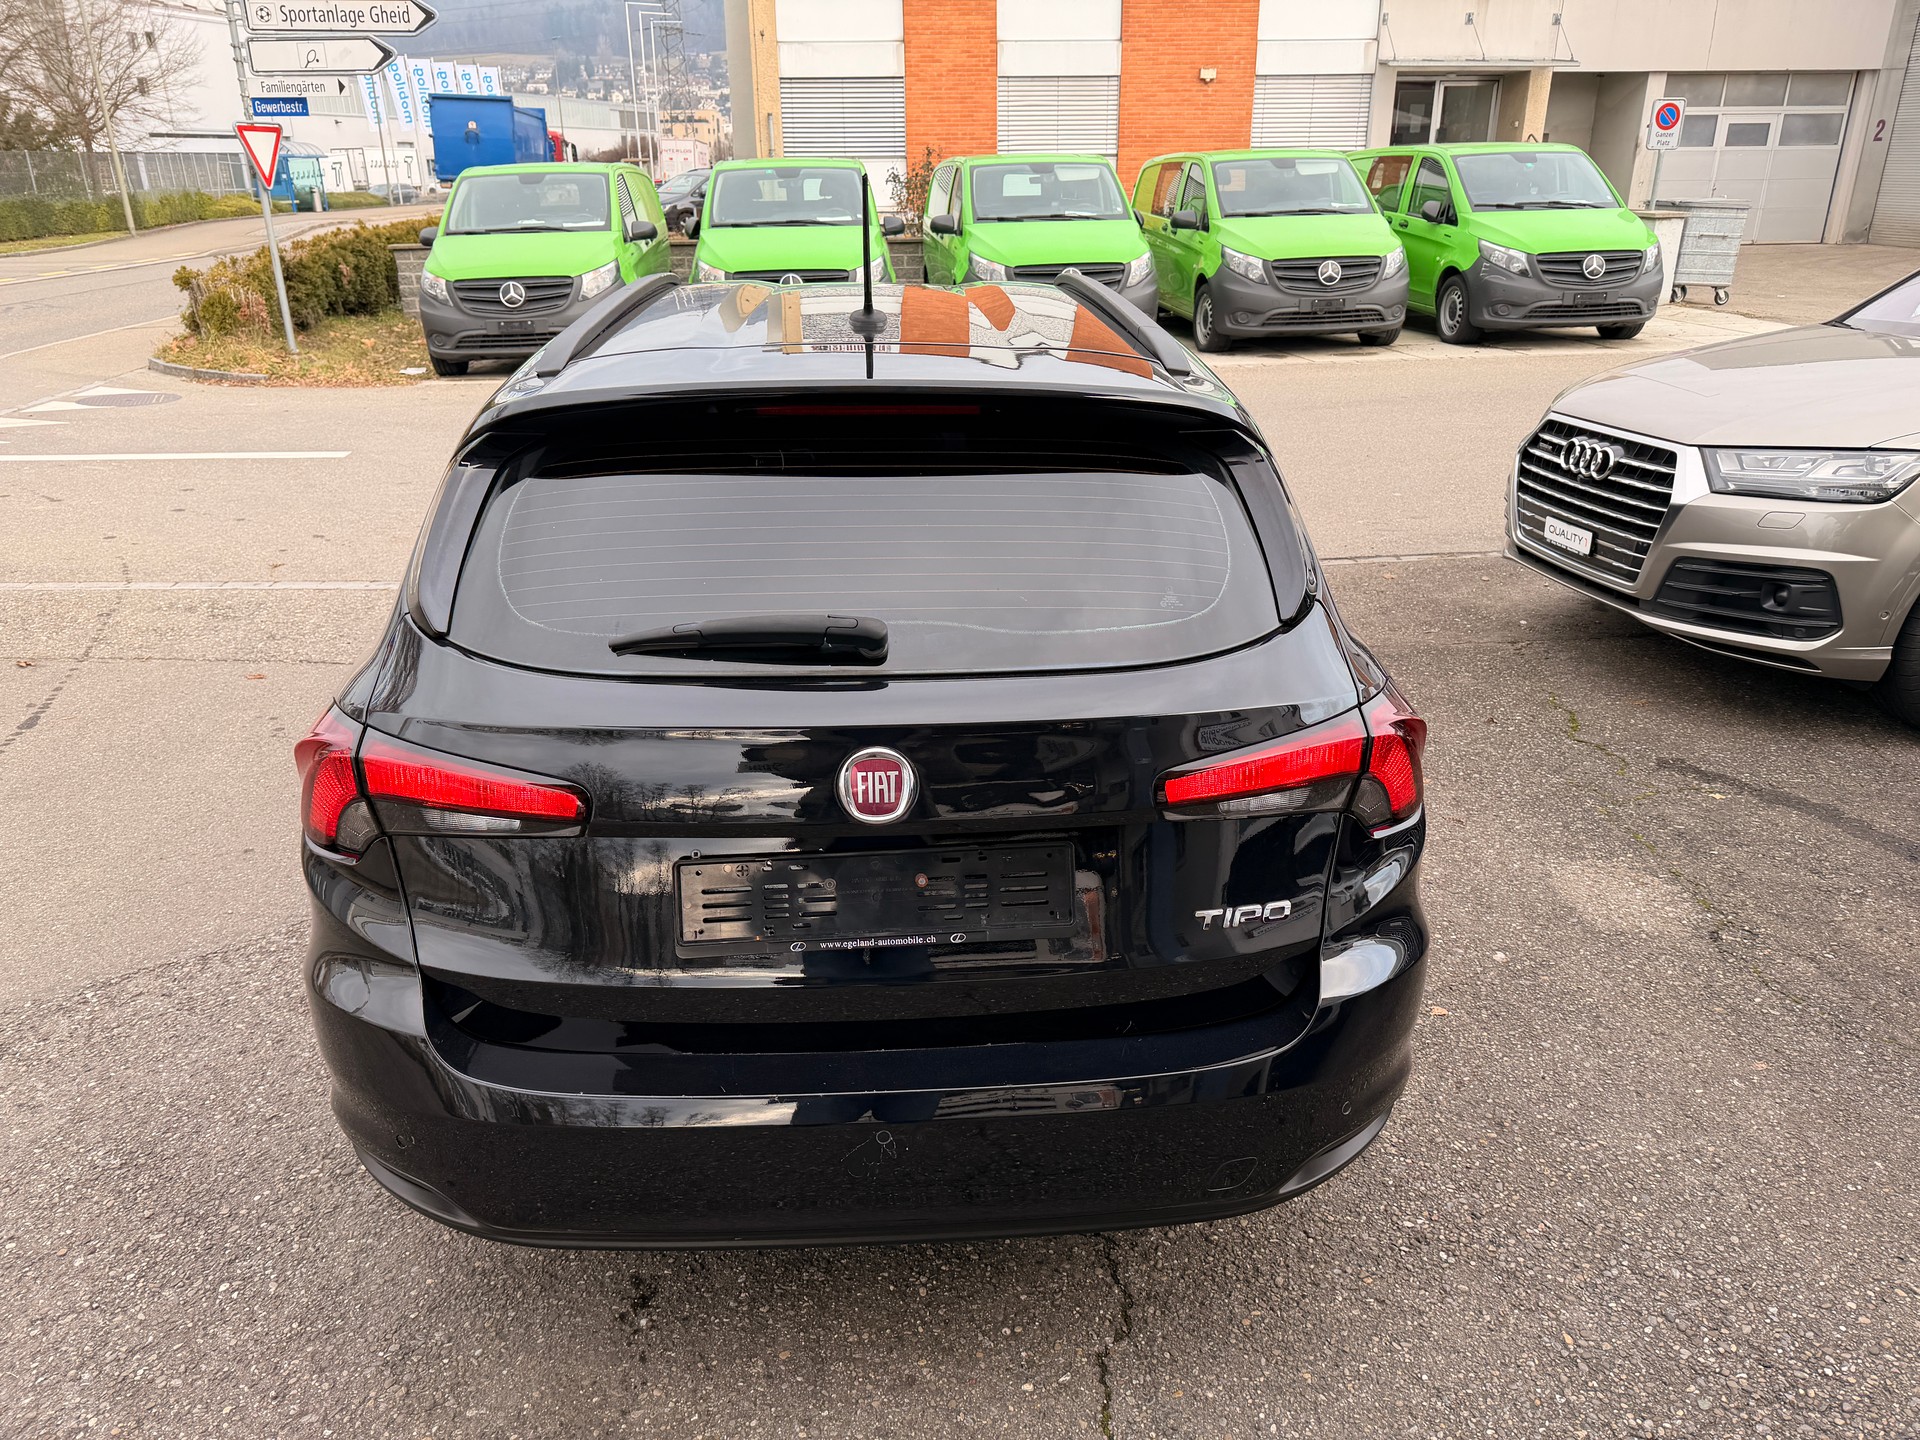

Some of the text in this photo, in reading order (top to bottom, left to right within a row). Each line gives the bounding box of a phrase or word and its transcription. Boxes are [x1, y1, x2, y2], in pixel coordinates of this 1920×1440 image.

[279, 2, 411, 28] Sportanlage Gheid
[260, 81, 326, 96] Familiengärten
[255, 101, 307, 114] Gewerbestr.
[1873, 119, 1886, 142] 2
[856, 770, 899, 804] FIAT
[1194, 899, 1292, 931] TIPO
[820, 935, 937, 950] www.egeland-automobile.ch
